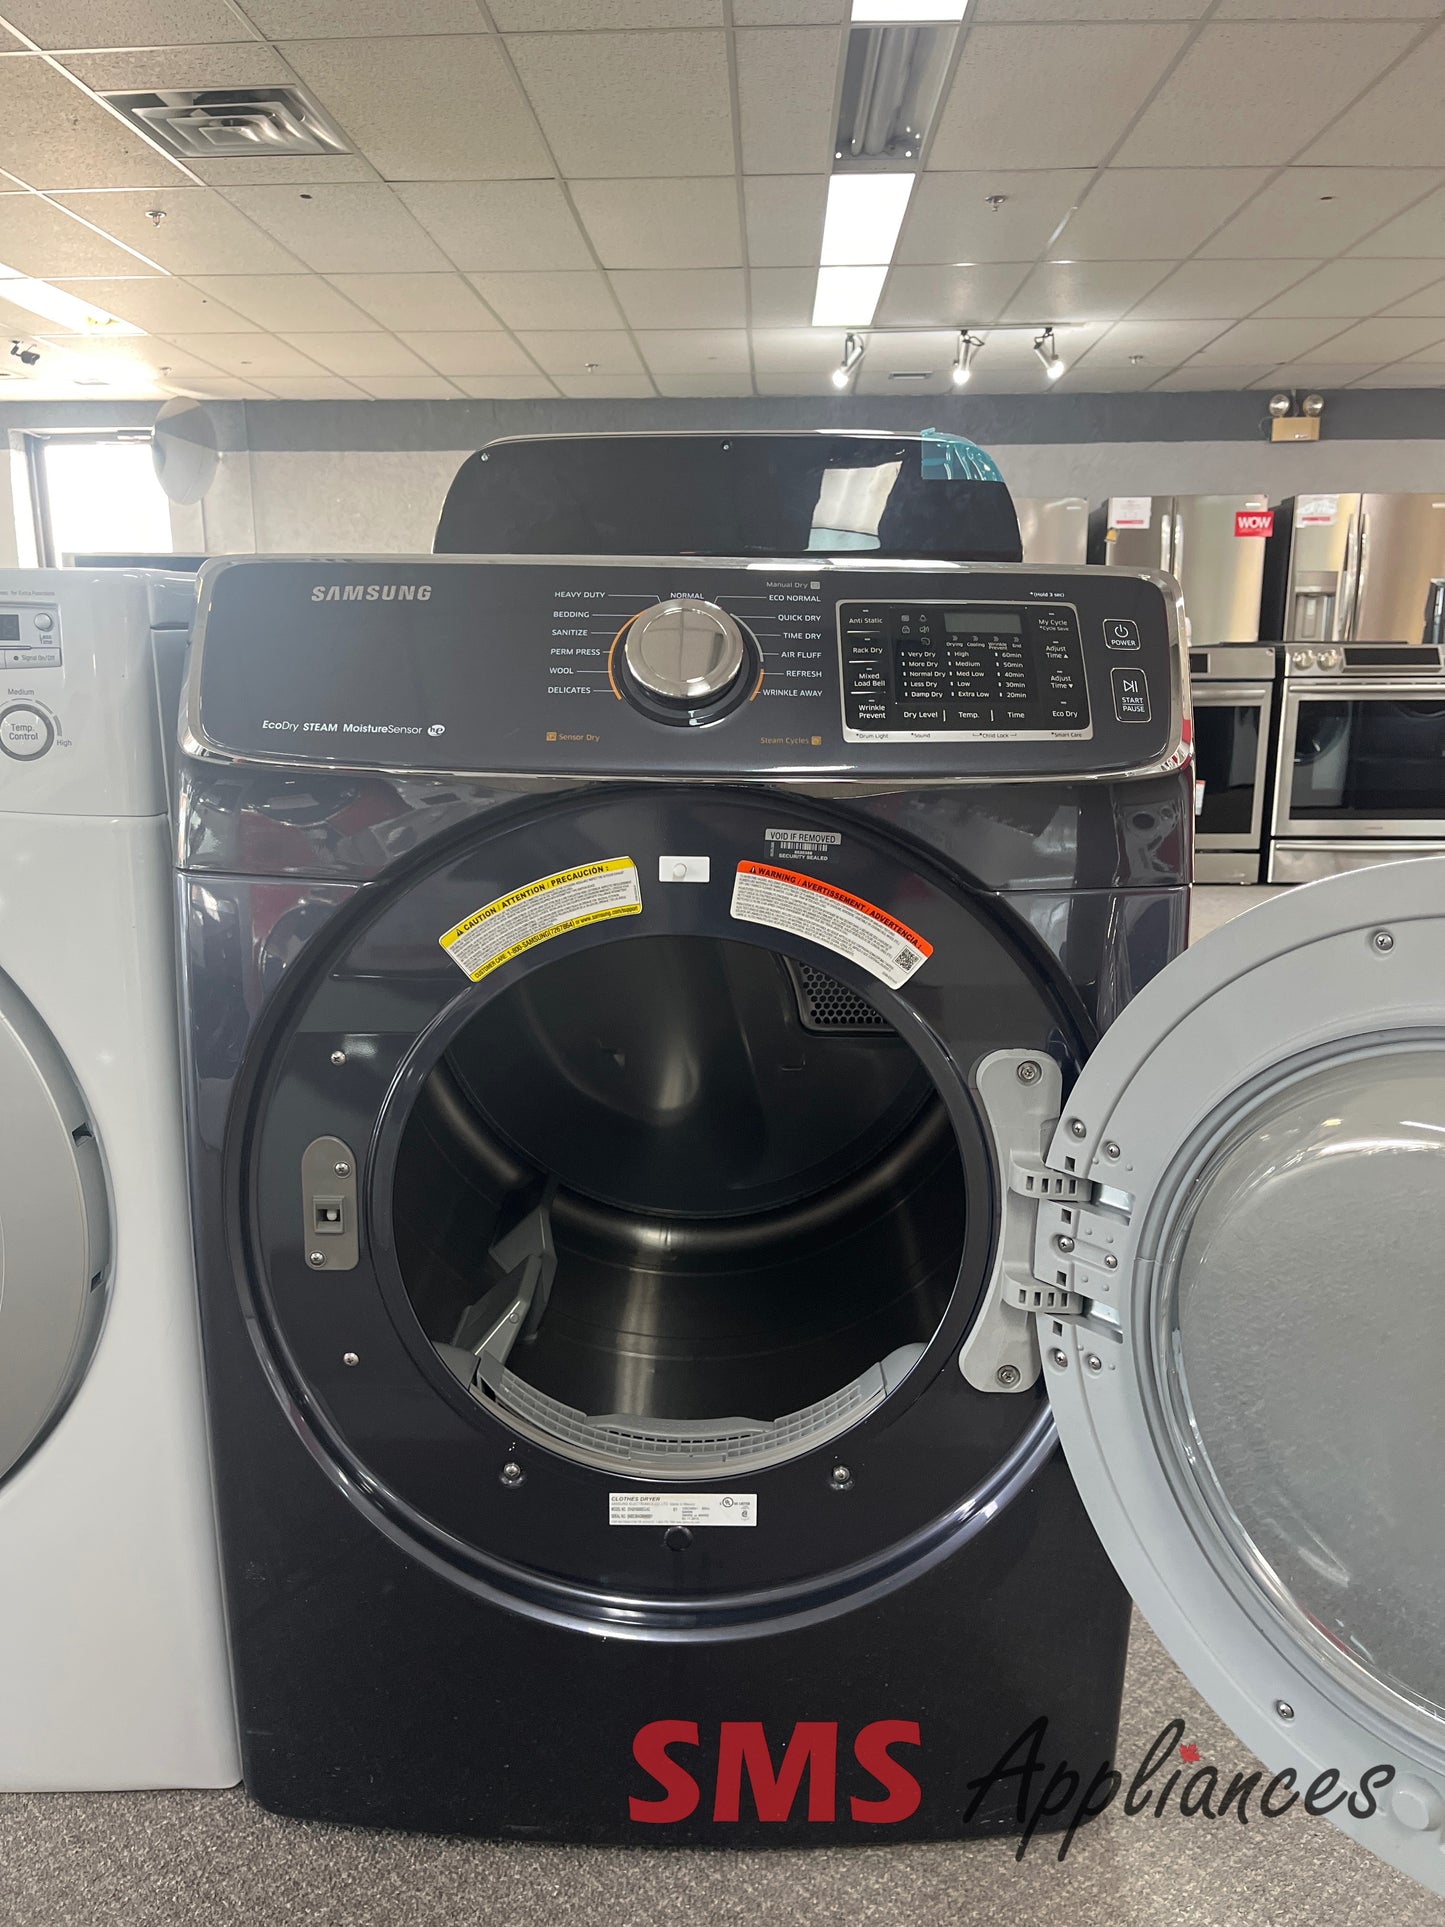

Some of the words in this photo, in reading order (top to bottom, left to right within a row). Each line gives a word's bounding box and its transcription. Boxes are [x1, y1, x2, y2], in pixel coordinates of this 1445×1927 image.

[1237, 516, 1272, 528] WOW
[311, 585, 432, 601] SAMSUNG
[805, 632, 822, 640] DRY
[1111, 639, 1137, 647] POWER
[550, 648, 574, 656] PERM
[576, 648, 601, 656] PRESS
[1045, 645, 1066, 653] Adjust
[786, 670, 822, 678] REFRESH
[1050, 675, 1072, 683] Adjust
[7, 688, 35, 696] Medium
[547, 686, 591, 694] DELICATES
[763, 689, 798, 697] WRINKLE
[800, 689, 823, 697] AWAY
[1122, 705, 1145, 713] PAUSE
[903, 711, 917, 719] Dry
[958, 711, 980, 719] Temp.
[1065, 710, 1078, 718] Dry
[262, 720, 300, 732] EcoDry
[303, 723, 338, 732] STEAM
[342, 723, 423, 735] MoistureSensor
[9, 732, 39, 740] Control
[559, 733, 584, 741] Sensor
[586, 734, 600, 742] Dry
[56, 740, 73, 748] High
[785, 736, 809, 746] Cycles
[770, 832, 788, 840] VOID
[790, 833, 797, 841] IF
[463, 908, 497, 931] CAUTION
[502, 884, 546, 909] ATTENTION
[551, 865, 604, 886] PRECAUCIÓN
[758, 867, 796, 884] WARNING
[802, 880, 866, 912] AVERTISSEMENT
[870, 910, 920, 947] ADVERTENCIA
[474, 960, 496, 978] CUSTOMER
